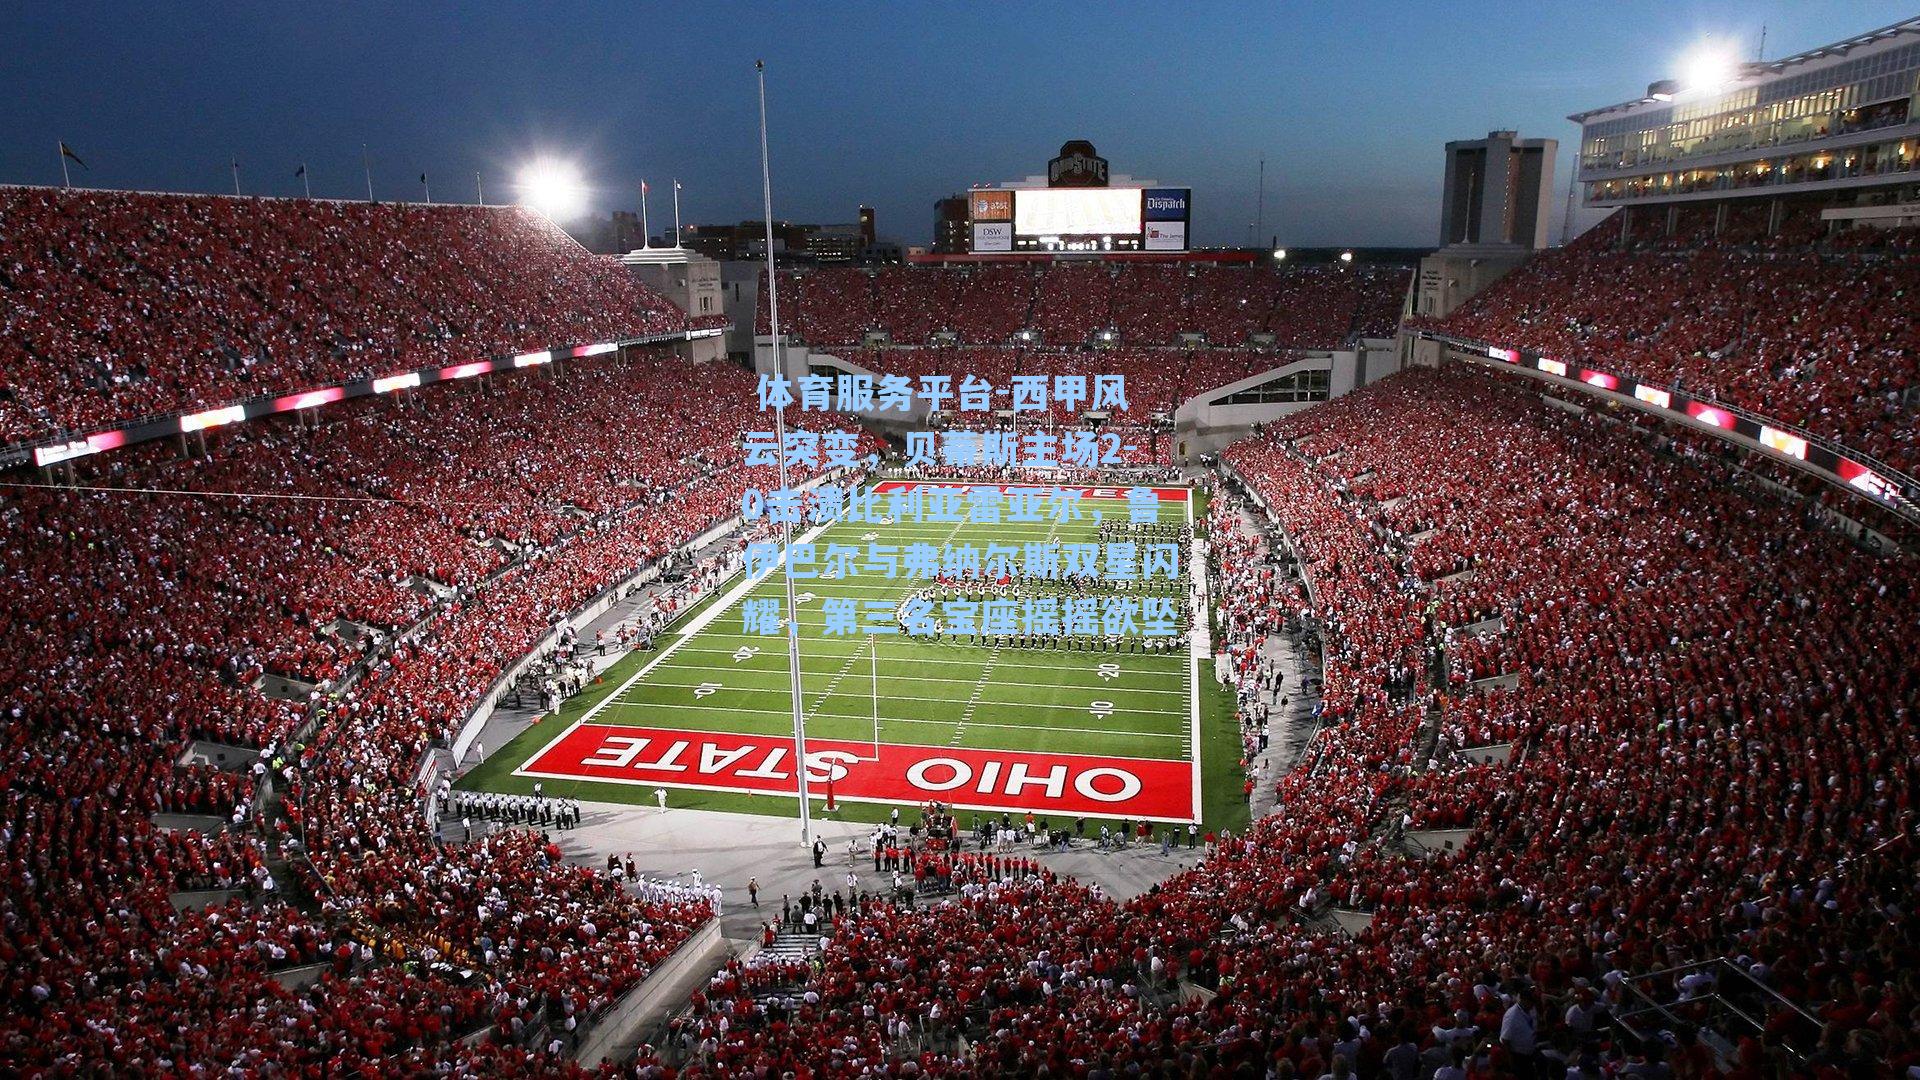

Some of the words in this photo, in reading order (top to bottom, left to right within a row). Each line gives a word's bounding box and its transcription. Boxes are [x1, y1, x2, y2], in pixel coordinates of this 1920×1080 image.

[1147, 197, 1185, 210] Dispatch
[983, 228, 1003, 236] DSW
[1097, 663, 1120, 678] 20
[1089, 701, 1114, 715] 10
[580, 736, 859, 783] STATE
[905, 757, 1142, 803] OHIO
